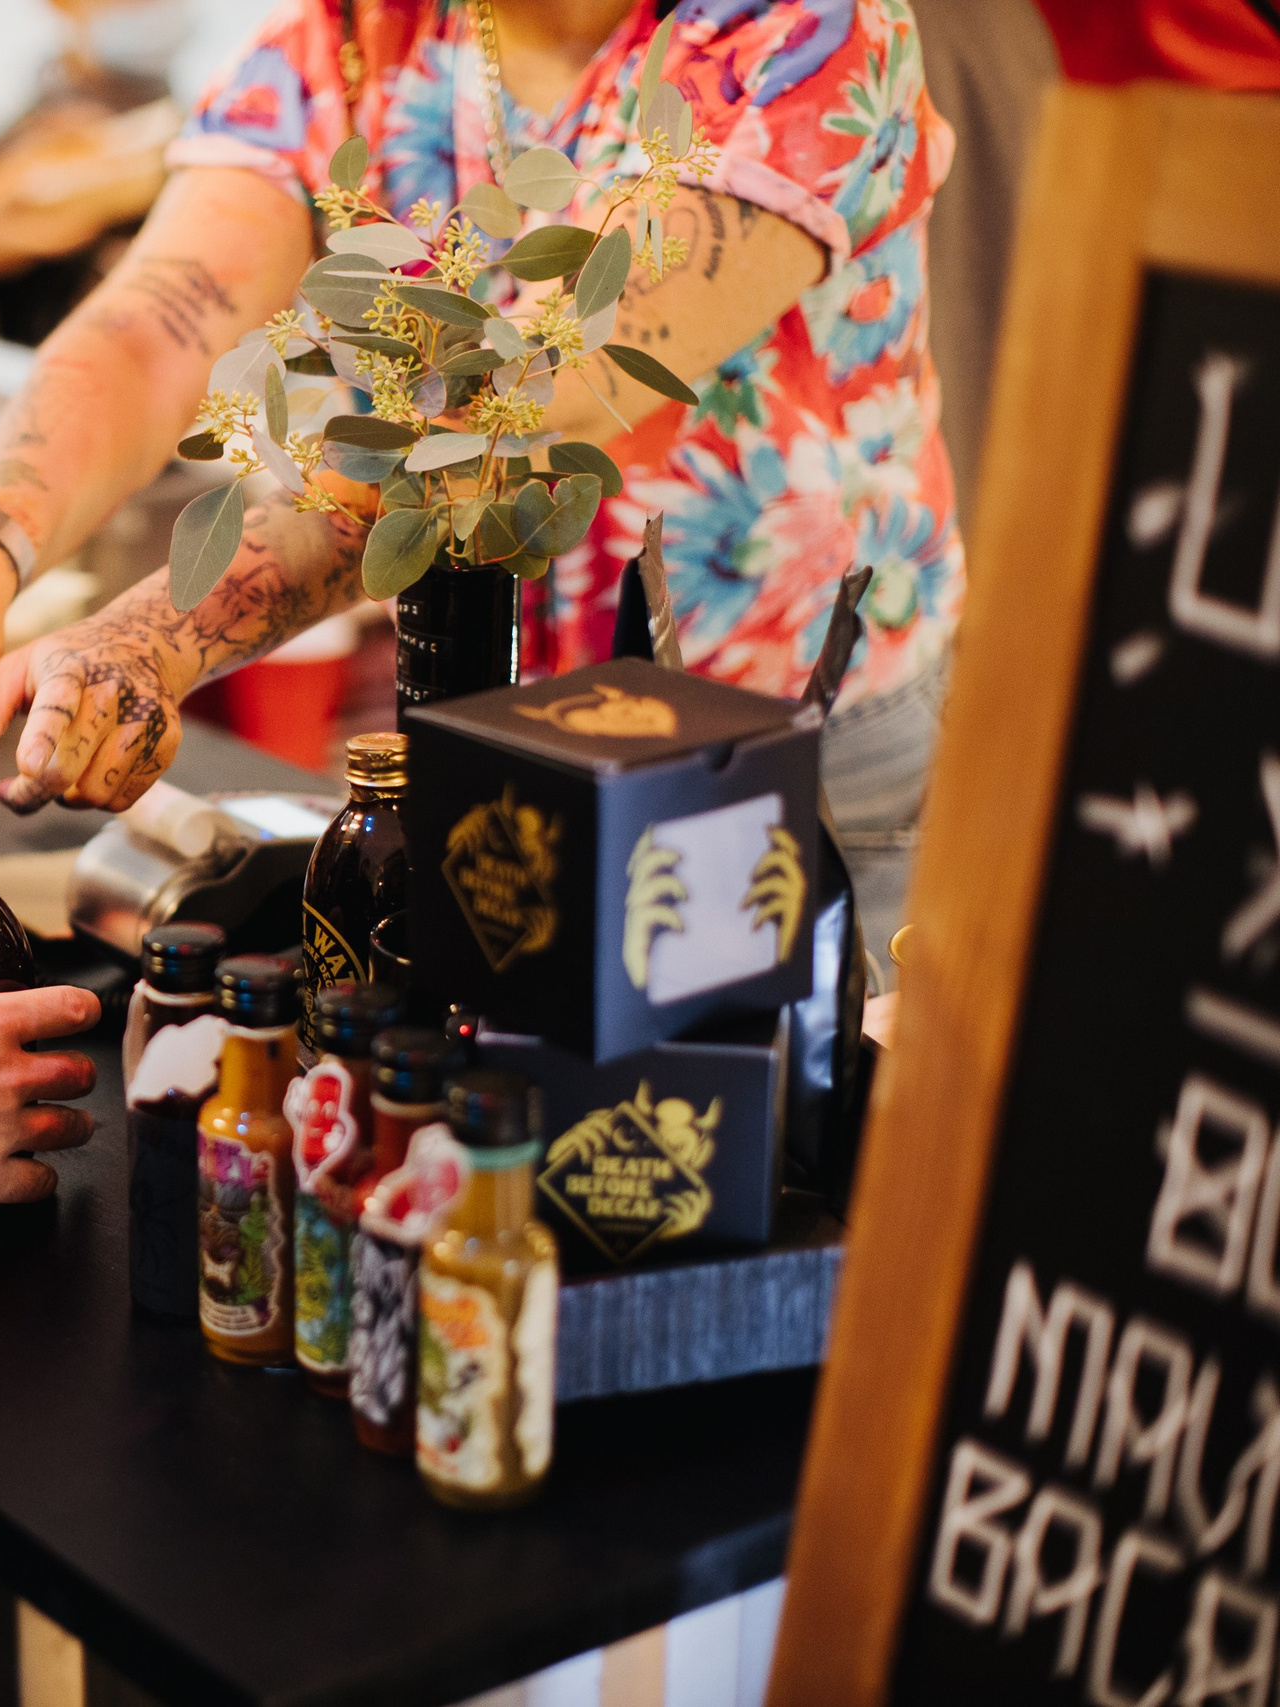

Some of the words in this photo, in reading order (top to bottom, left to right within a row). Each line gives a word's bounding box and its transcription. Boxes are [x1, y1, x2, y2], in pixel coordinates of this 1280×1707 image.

[319, 963, 334, 989] DEC
[592, 1155, 674, 1181] DEATH
[565, 1173, 653, 1198] BEFORE
[586, 1197, 662, 1220] DECAF
